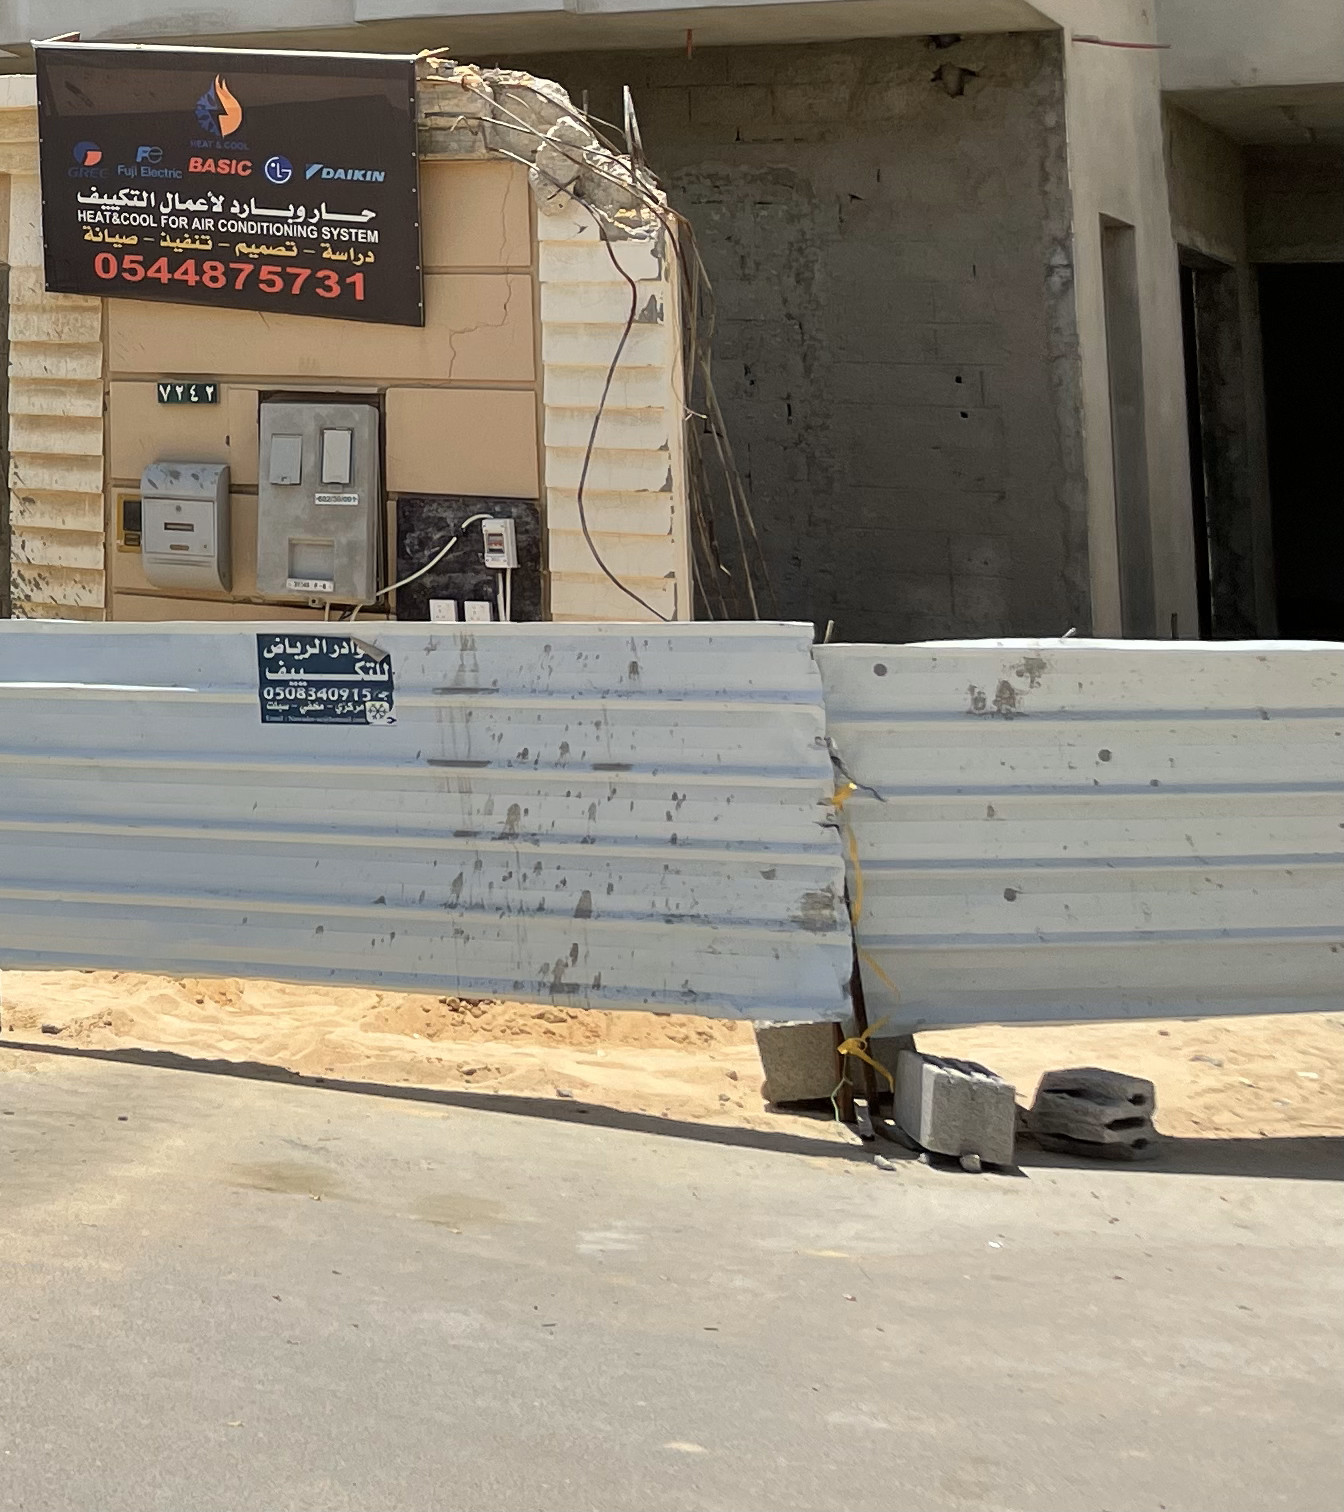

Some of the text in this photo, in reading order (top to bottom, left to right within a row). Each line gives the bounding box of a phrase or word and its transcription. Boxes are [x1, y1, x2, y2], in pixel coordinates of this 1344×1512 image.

[223, 140, 251, 151] COOL
[117, 164, 183, 179] Fuji Electric
[188, 156, 253, 177] BASIC
[321, 167, 386, 183] DAIKIN
[76, 186, 156, 211] التكييف
[159, 190, 225, 214] لأعمال
[77, 209, 379, 243] HEAT&COOL FOR AIR CONDITIONING SYSTEM
[82, 225, 139, 248] صيانة
[159, 231, 213, 253] تنفيذ
[234, 240, 298, 259] تصميم
[319, 241, 375, 266] دراسة
[94, 251, 365, 301] 0544875731
[263, 637, 367, 660] وادر الرياض
[265, 660, 390, 686] للتكييف
[263, 686, 372, 701] 0508340915
